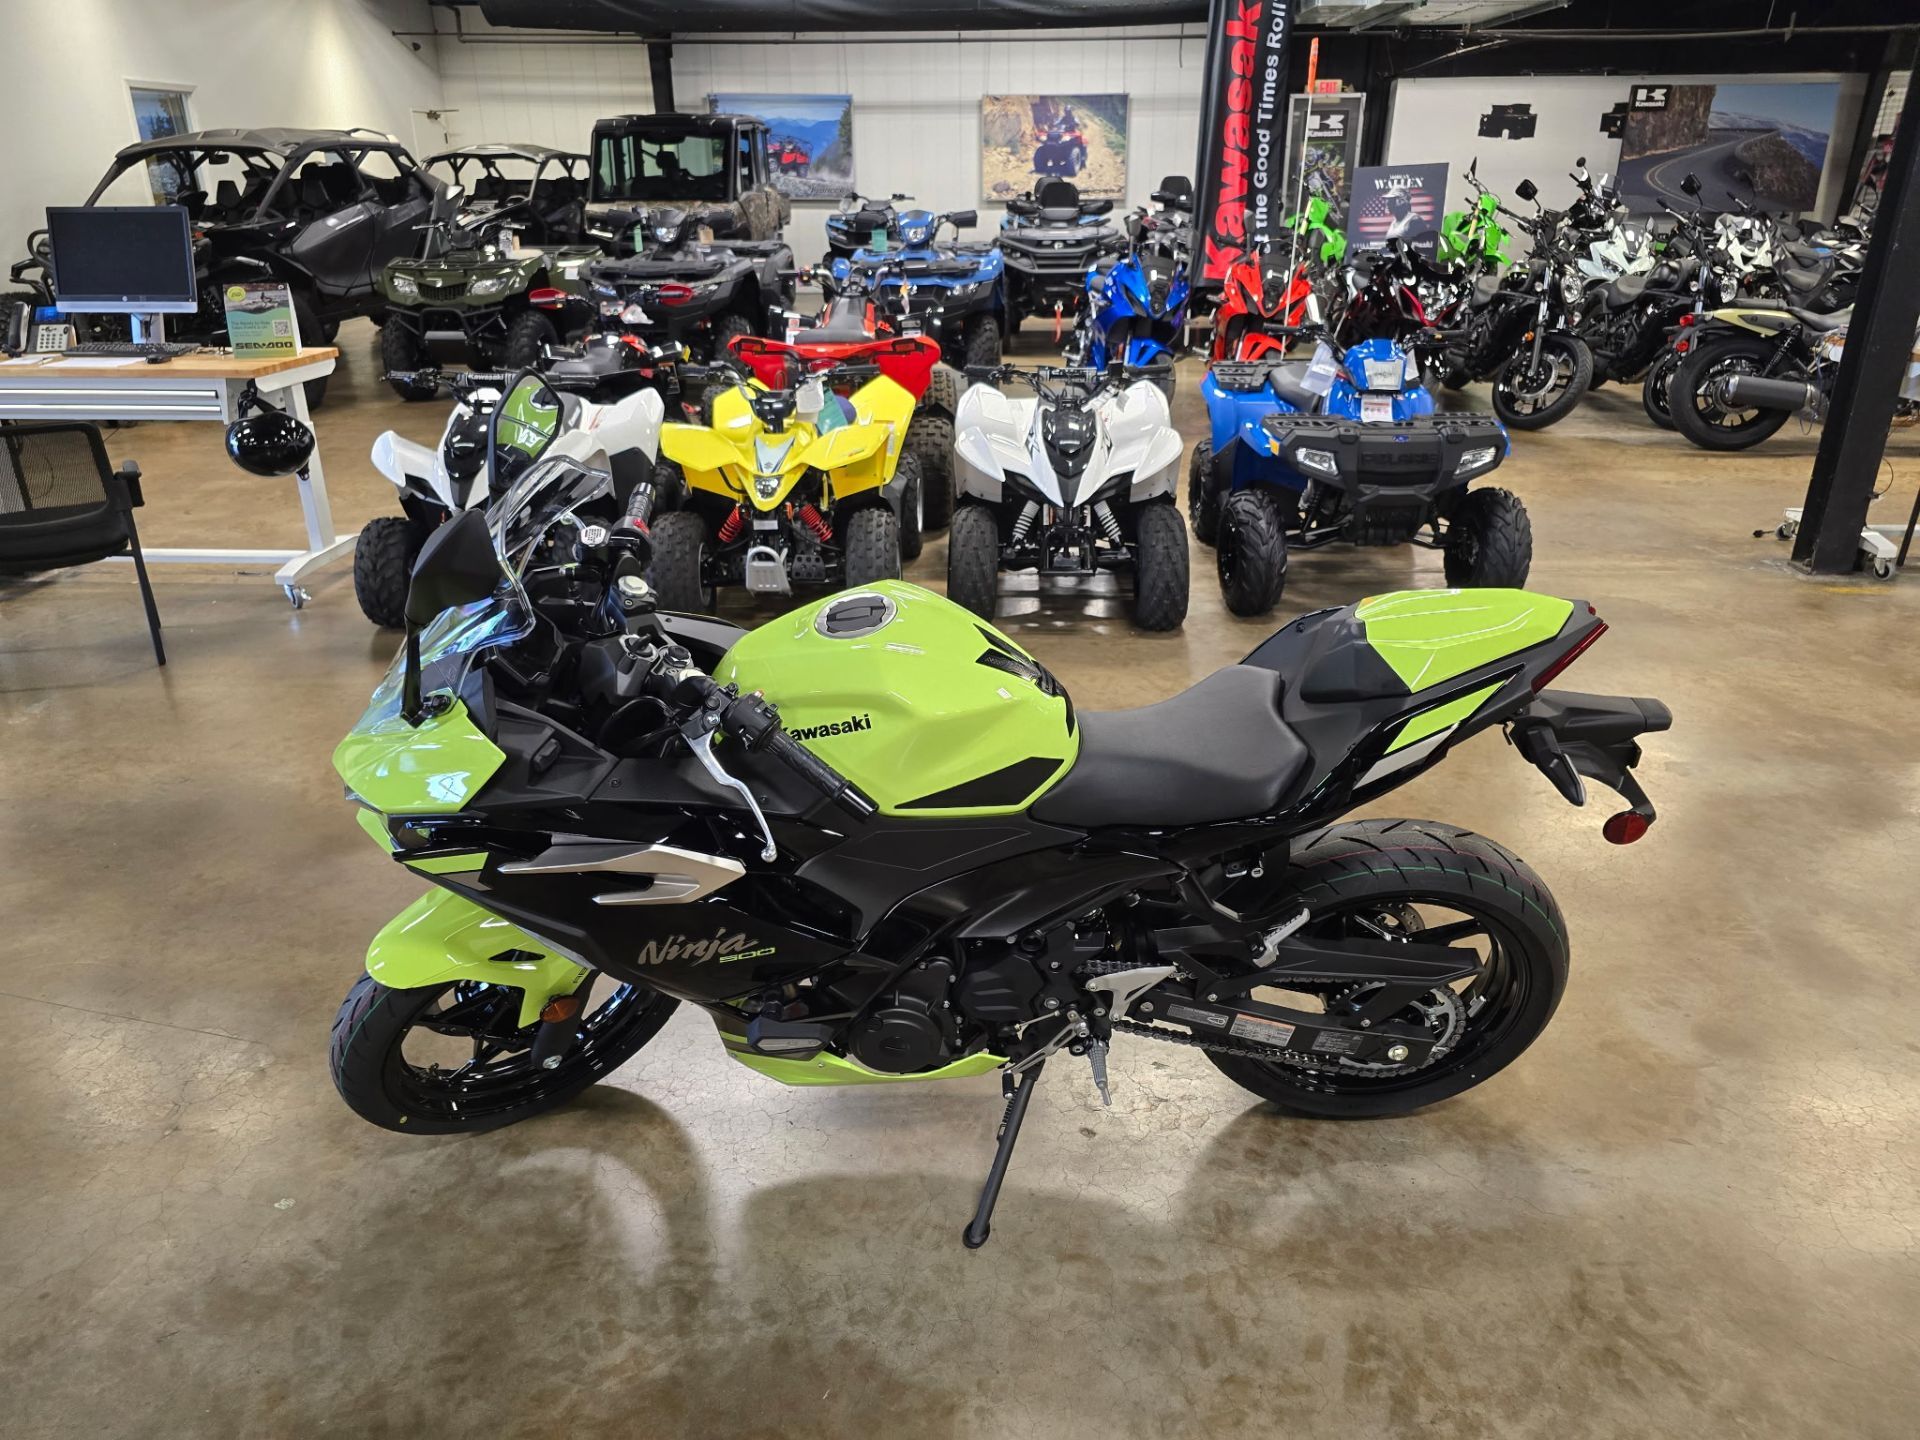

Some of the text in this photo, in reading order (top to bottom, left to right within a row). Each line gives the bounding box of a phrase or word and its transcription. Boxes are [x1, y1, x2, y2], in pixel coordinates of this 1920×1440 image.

[1266, 0, 1287, 49] Roll
[1257, 54, 1280, 123] Times
[1203, 0, 1263, 279] Kawasak
[1253, 129, 1271, 189] Good
[783, 713, 872, 742] awasaki
[637, 926, 776, 967] Ninja 500
